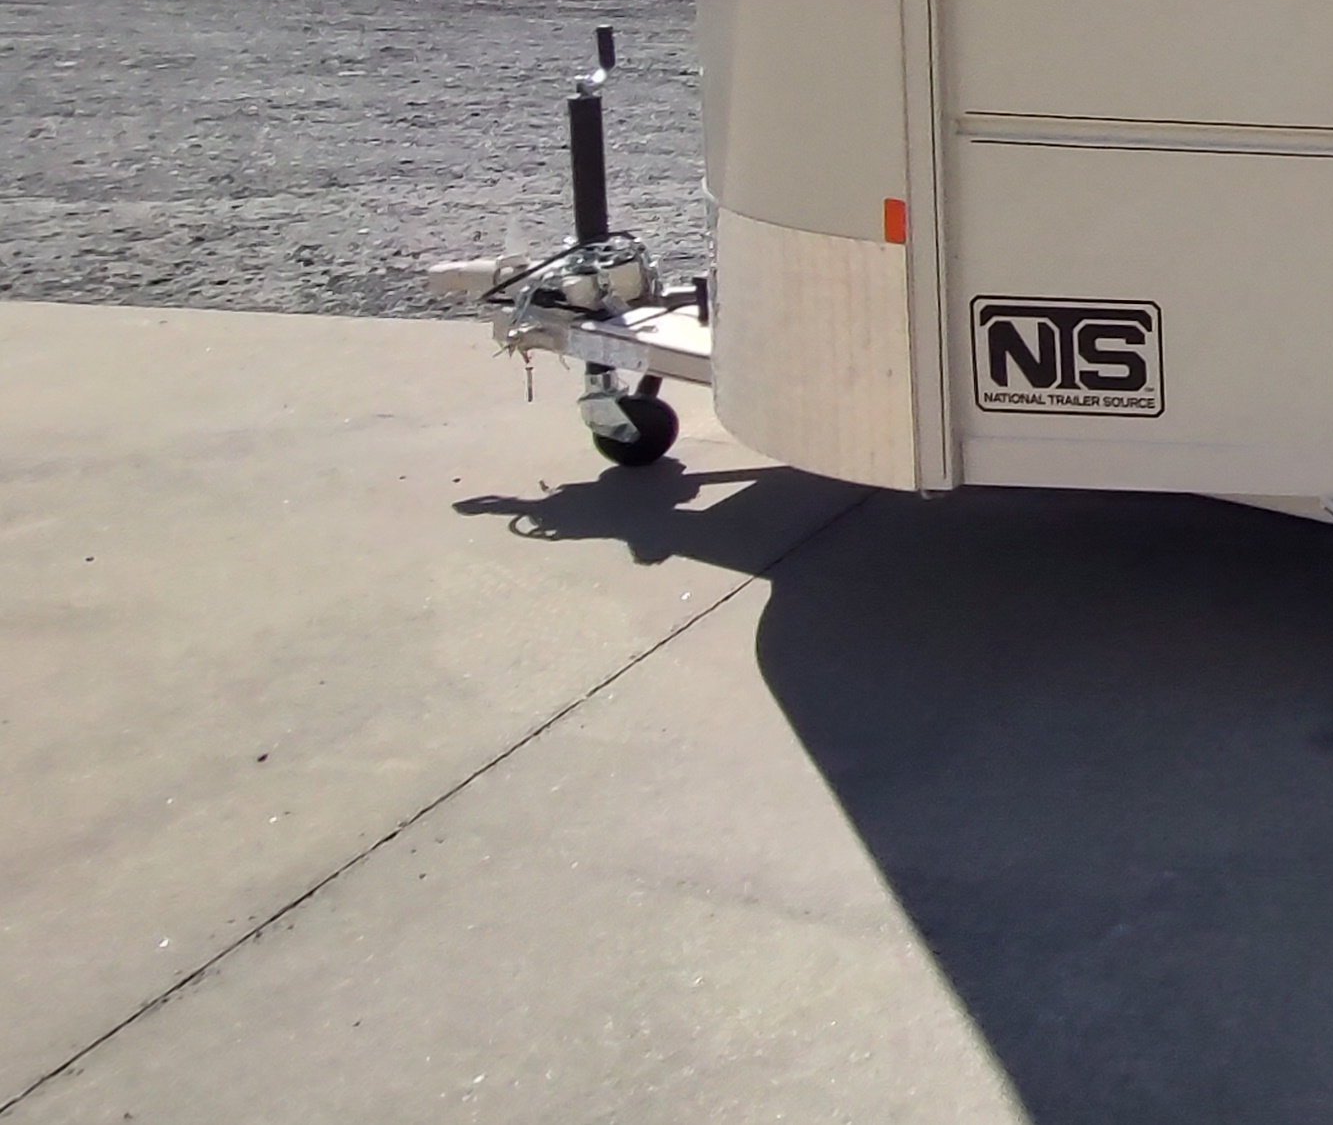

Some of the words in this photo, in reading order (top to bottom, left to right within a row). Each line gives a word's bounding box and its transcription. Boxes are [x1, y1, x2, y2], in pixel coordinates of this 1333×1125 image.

[980, 305, 1153, 391] NTS
[984, 392, 1046, 406] NATIONAL
[1048, 394, 1100, 407] TRAILER
[1103, 396, 1156, 409] SOURCE
